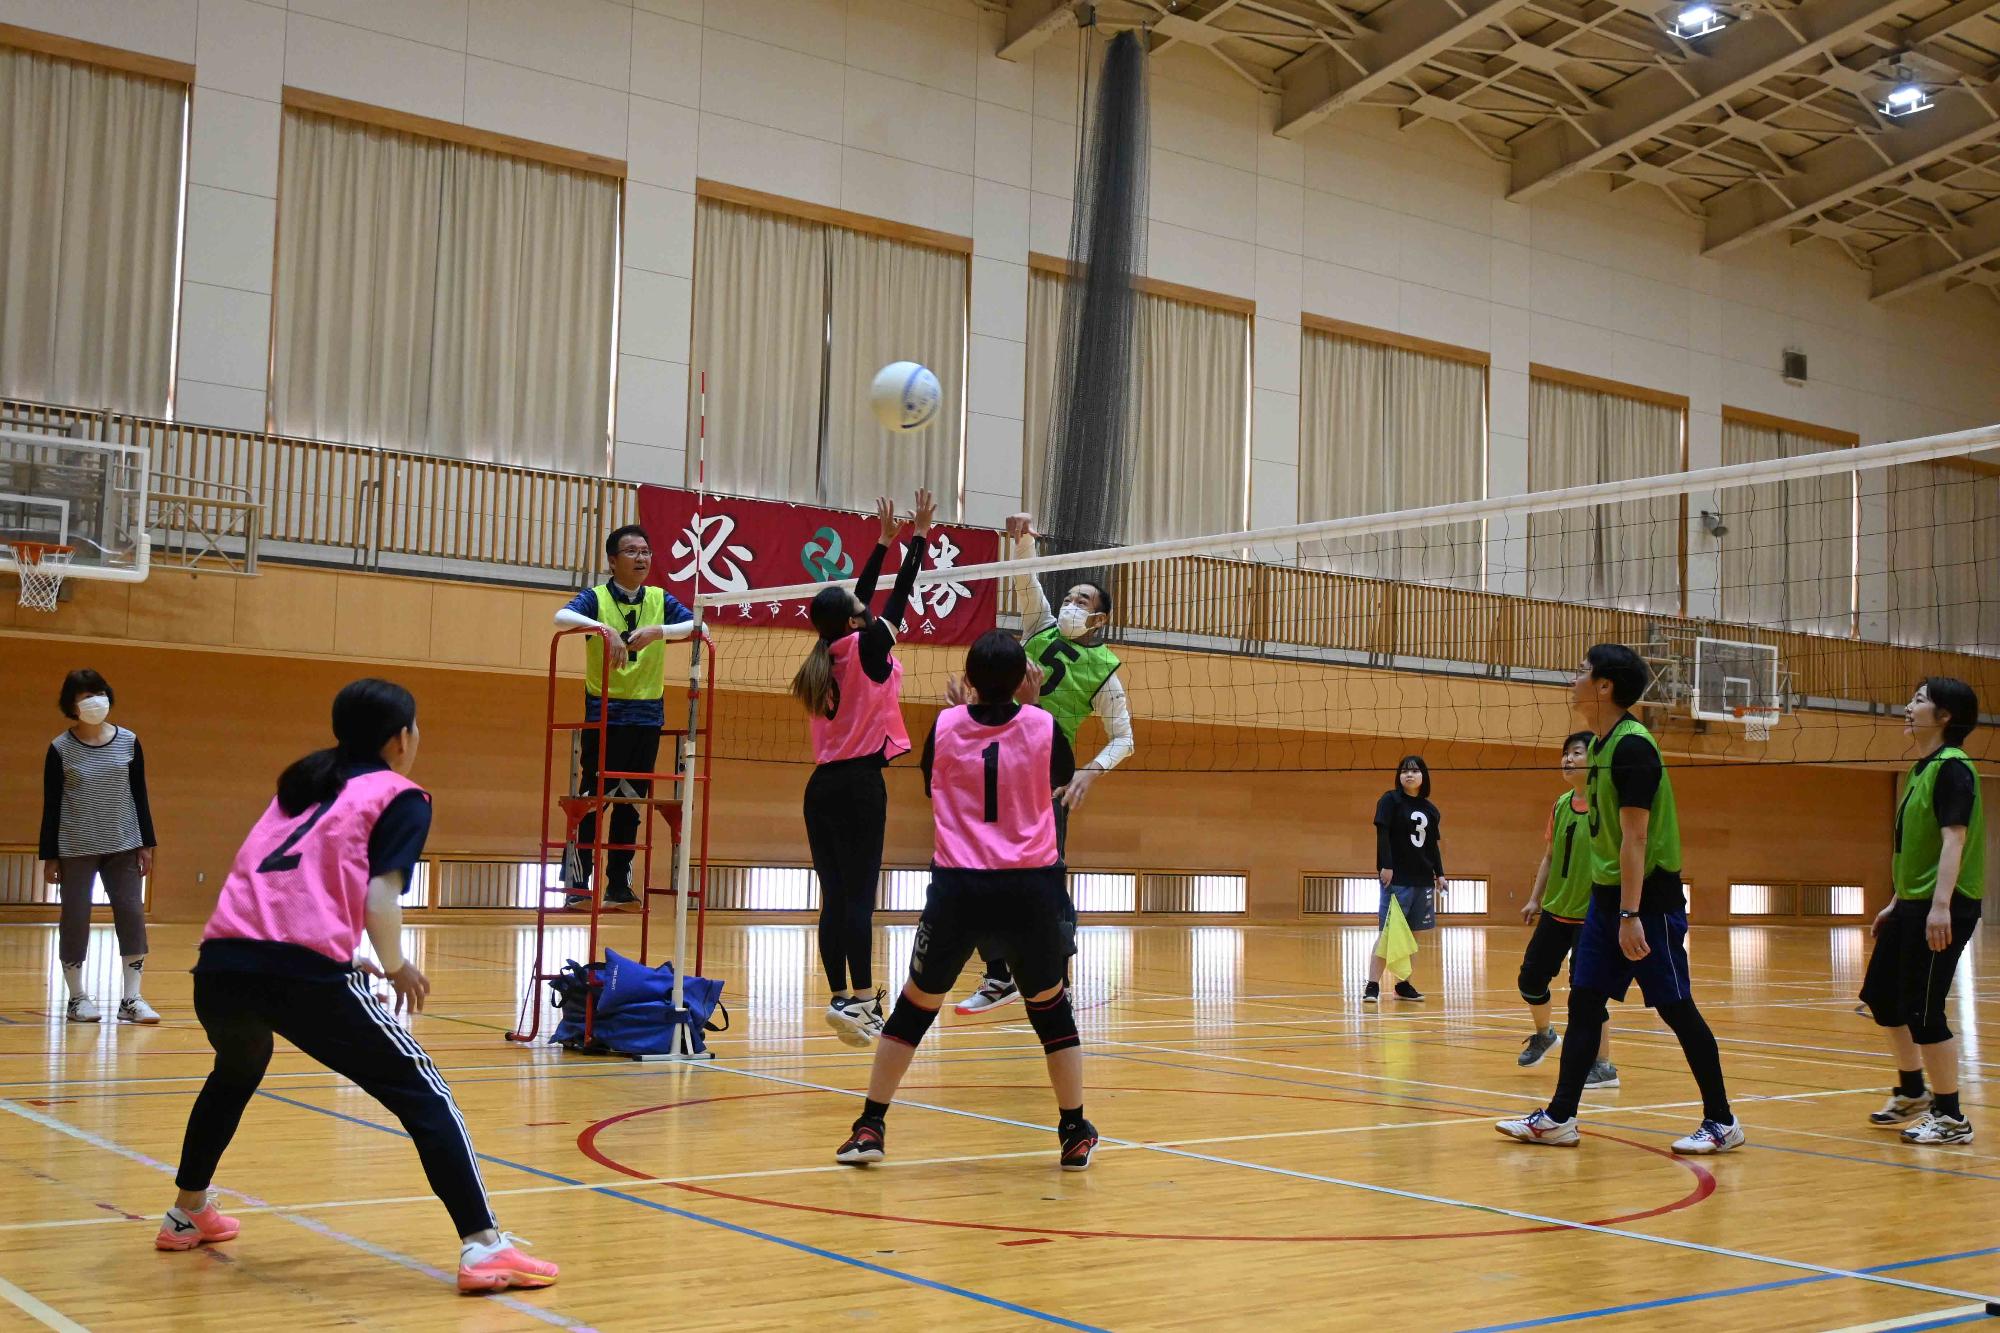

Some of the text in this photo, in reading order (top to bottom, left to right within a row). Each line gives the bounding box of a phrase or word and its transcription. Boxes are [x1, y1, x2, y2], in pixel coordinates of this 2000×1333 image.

[668, 512, 753, 592] 必
[624, 610, 637, 662] 1
[1039, 639, 1081, 697] 5
[981, 741, 1000, 823] 1
[256, 793, 339, 873] 2
[1410, 811, 1428, 848] 3
[1562, 821, 1578, 879] 1
